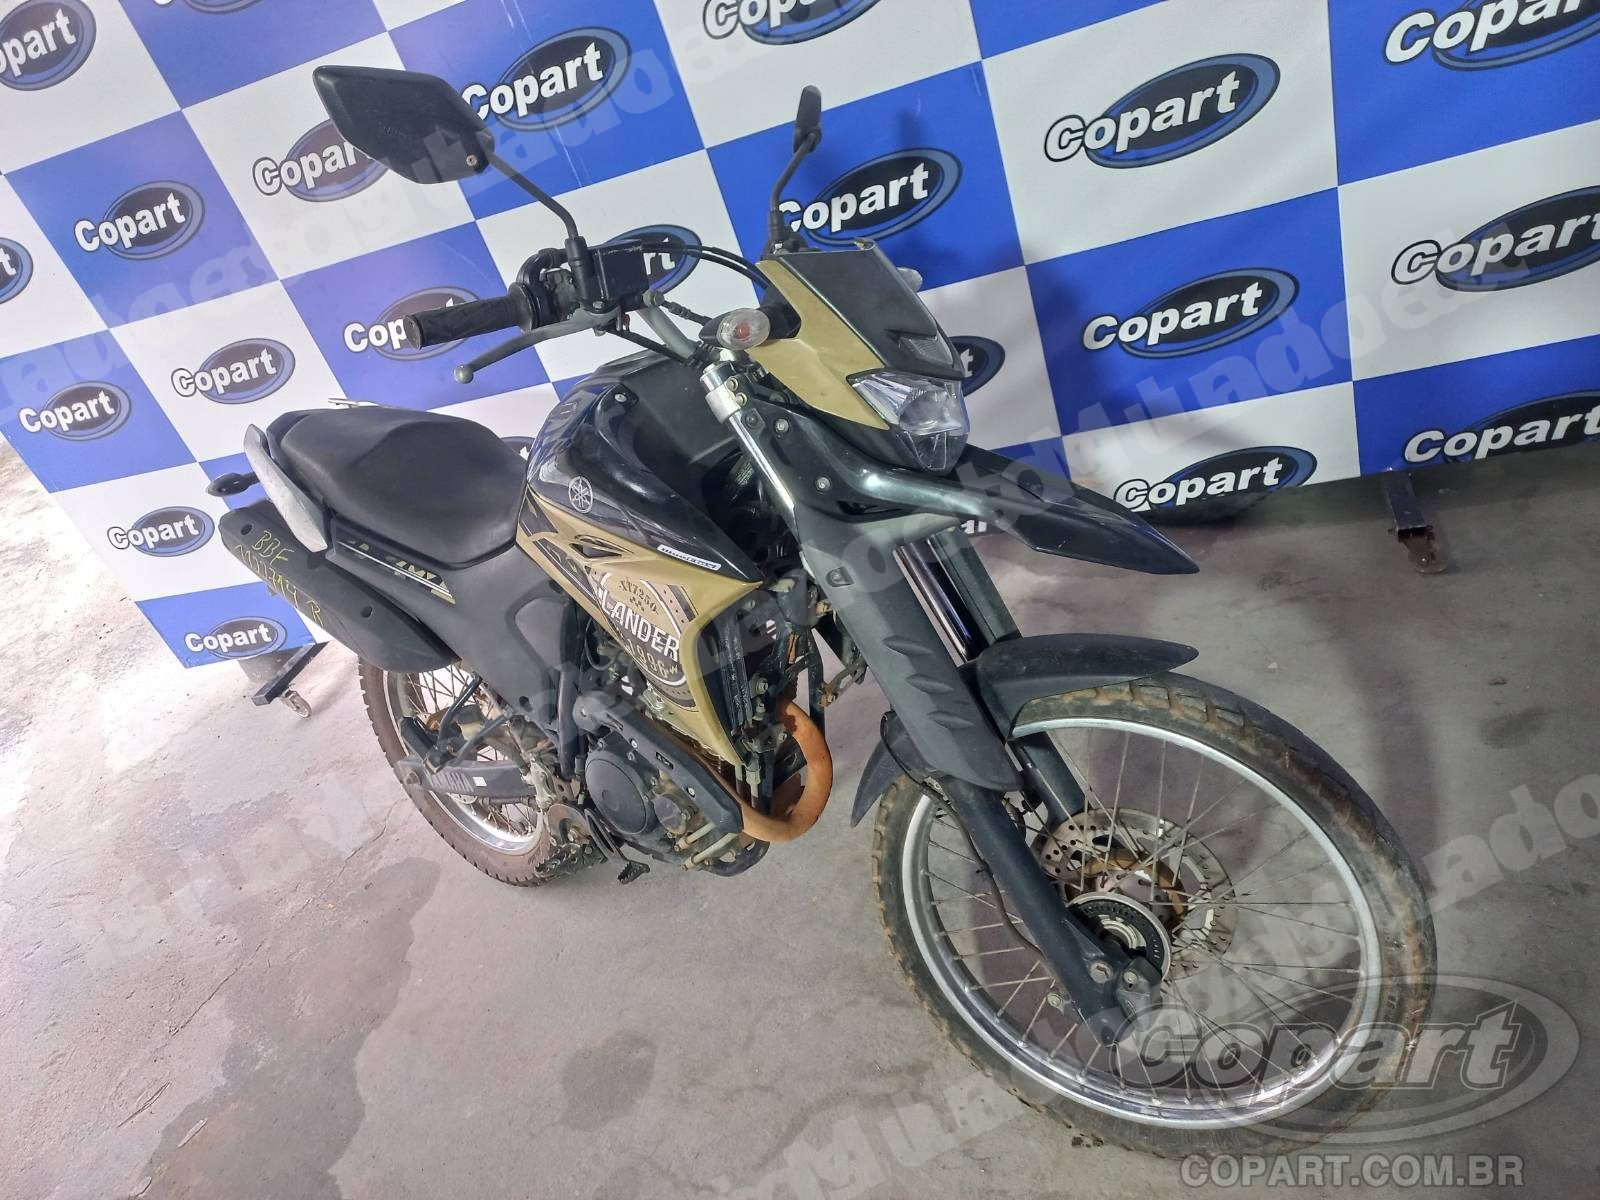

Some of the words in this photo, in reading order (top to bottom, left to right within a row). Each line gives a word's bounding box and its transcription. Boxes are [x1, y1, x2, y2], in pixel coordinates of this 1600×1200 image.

[1045, 70, 1239, 161] Copart
[75, 192, 185, 251] Copart
[1082, 281, 1262, 350] Copart
[172, 348, 278, 397] Copart
[18, 389, 115, 432] Copart
[1114, 457, 1283, 509] Copart
[107, 514, 200, 549] Copart
[185, 623, 272, 652] Copart
[599, 587, 680, 662] LANDER
